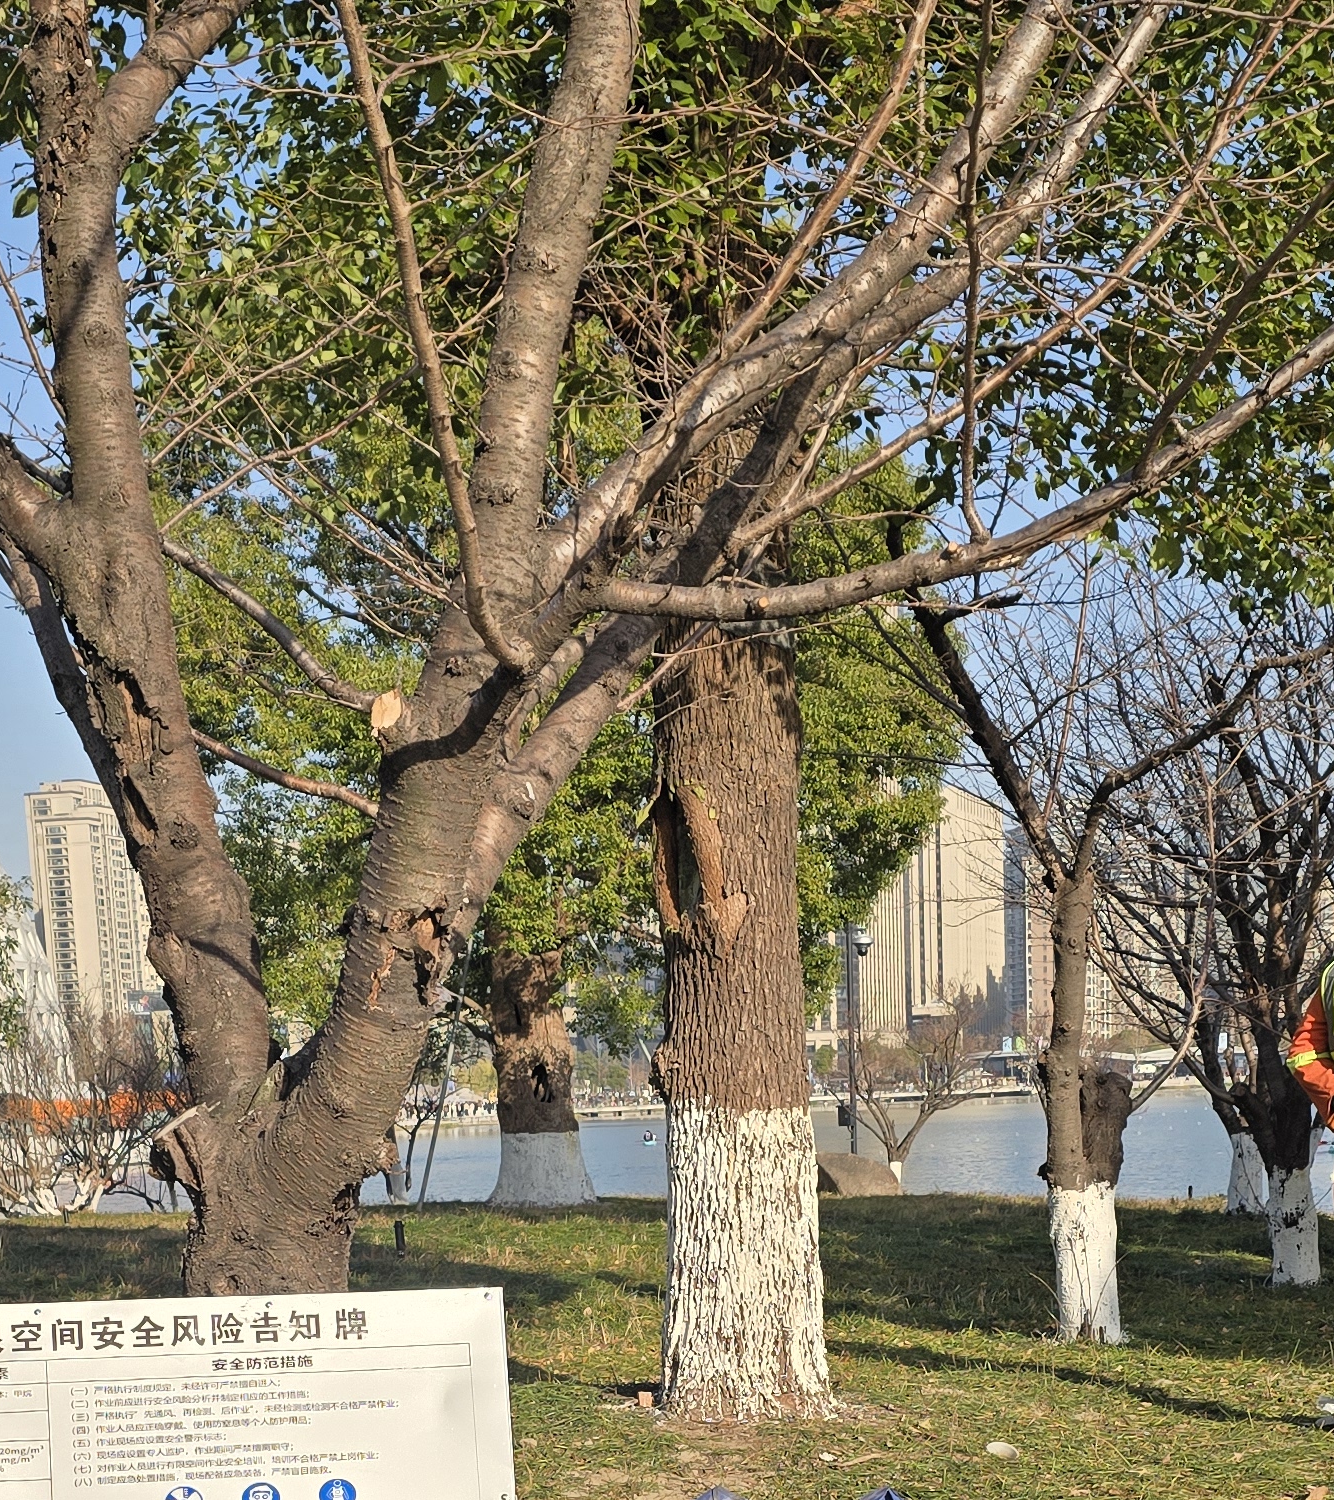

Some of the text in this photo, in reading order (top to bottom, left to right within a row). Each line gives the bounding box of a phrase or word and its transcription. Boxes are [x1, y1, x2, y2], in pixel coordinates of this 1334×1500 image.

[212, 1355, 313, 1372] 安全防范措施
